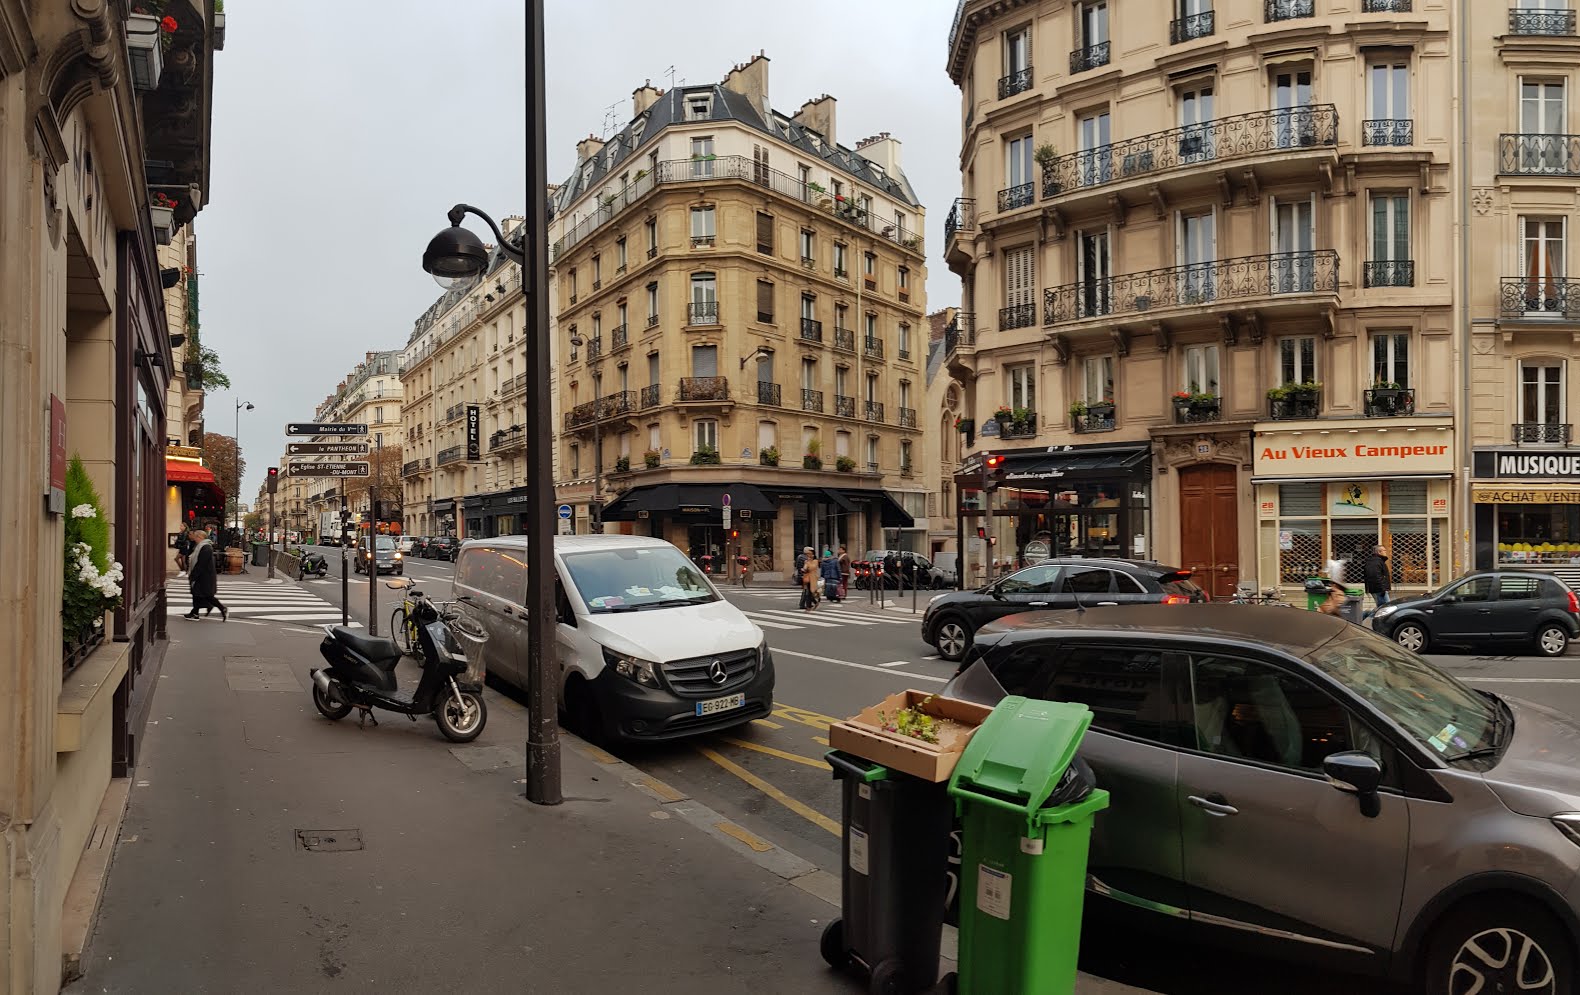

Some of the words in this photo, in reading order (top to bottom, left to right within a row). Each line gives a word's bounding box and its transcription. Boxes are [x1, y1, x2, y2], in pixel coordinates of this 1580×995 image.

[1260, 447, 1287, 461] Au
[1290, 446, 1348, 459] Vieux
[1354, 444, 1448, 459] Campeur
[300, 463, 316, 471] Eglise
[1499, 455, 1580, 475] MUSIQUE
[1492, 491, 1536, 502] ACHAT
